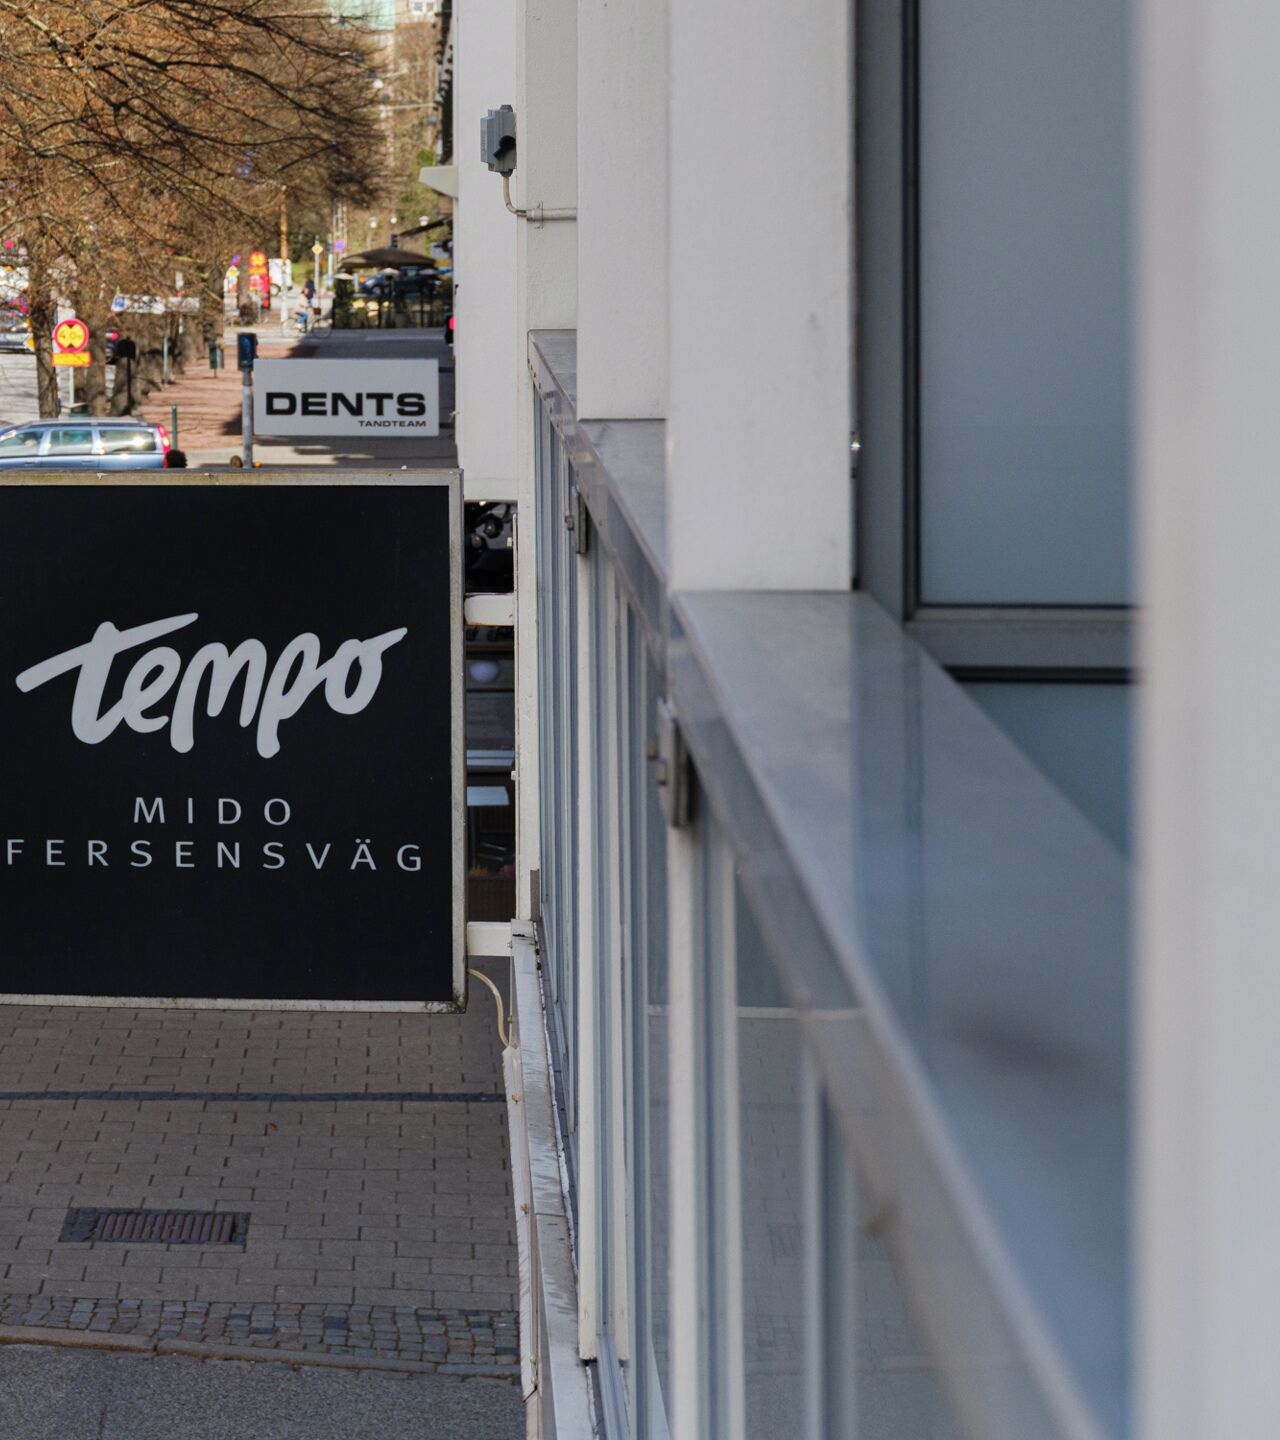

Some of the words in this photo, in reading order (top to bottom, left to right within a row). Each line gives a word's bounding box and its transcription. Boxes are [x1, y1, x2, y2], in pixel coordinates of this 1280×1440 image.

[265, 391, 426, 417] DENTS
[357, 420, 427, 428] TANDTEAM
[16, 612, 407, 758] tempo
[133, 796, 291, 826] MIDO
[7, 838, 422, 872] FERSENSVÄG
